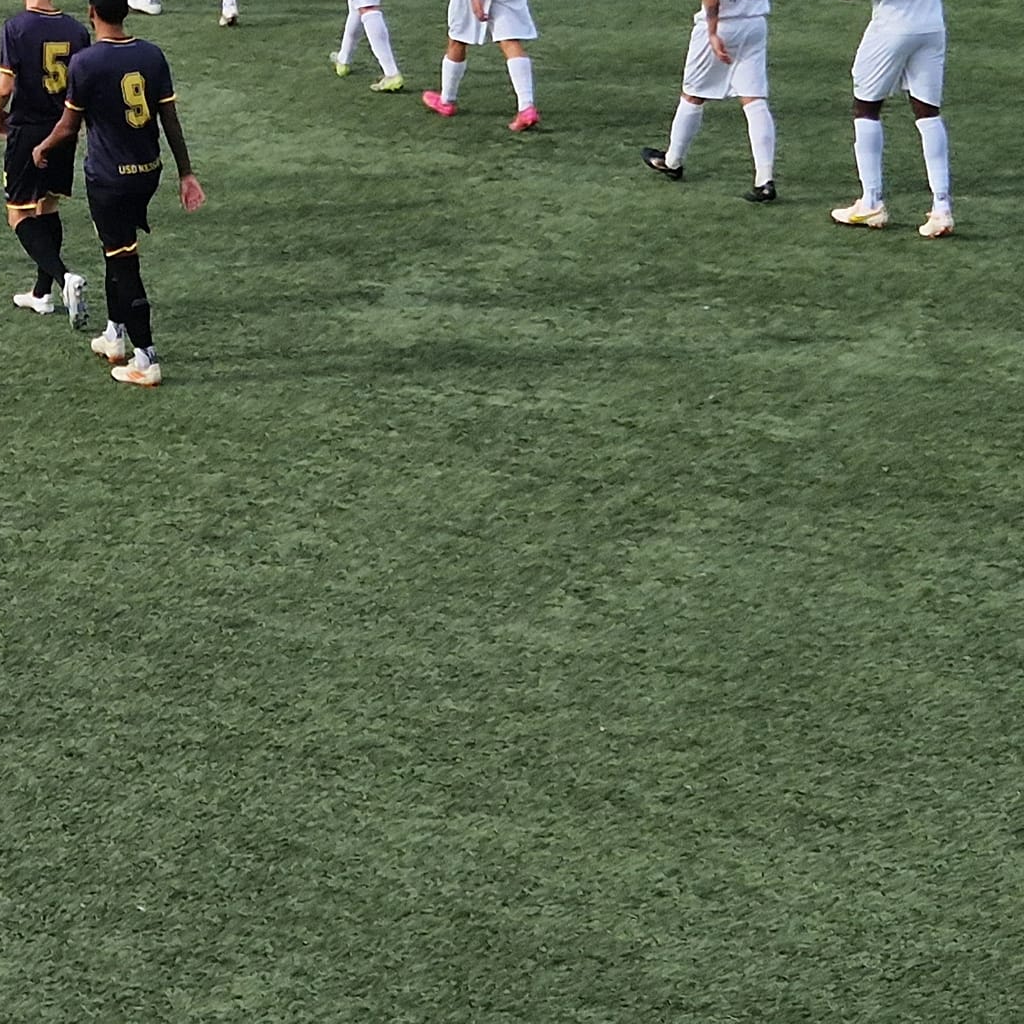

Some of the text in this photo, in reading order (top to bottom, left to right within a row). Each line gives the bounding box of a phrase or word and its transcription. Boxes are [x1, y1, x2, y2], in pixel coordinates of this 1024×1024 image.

[42, 41, 71, 94] 5
[120, 71, 152, 129] 9
[118, 164, 138, 175] USD
